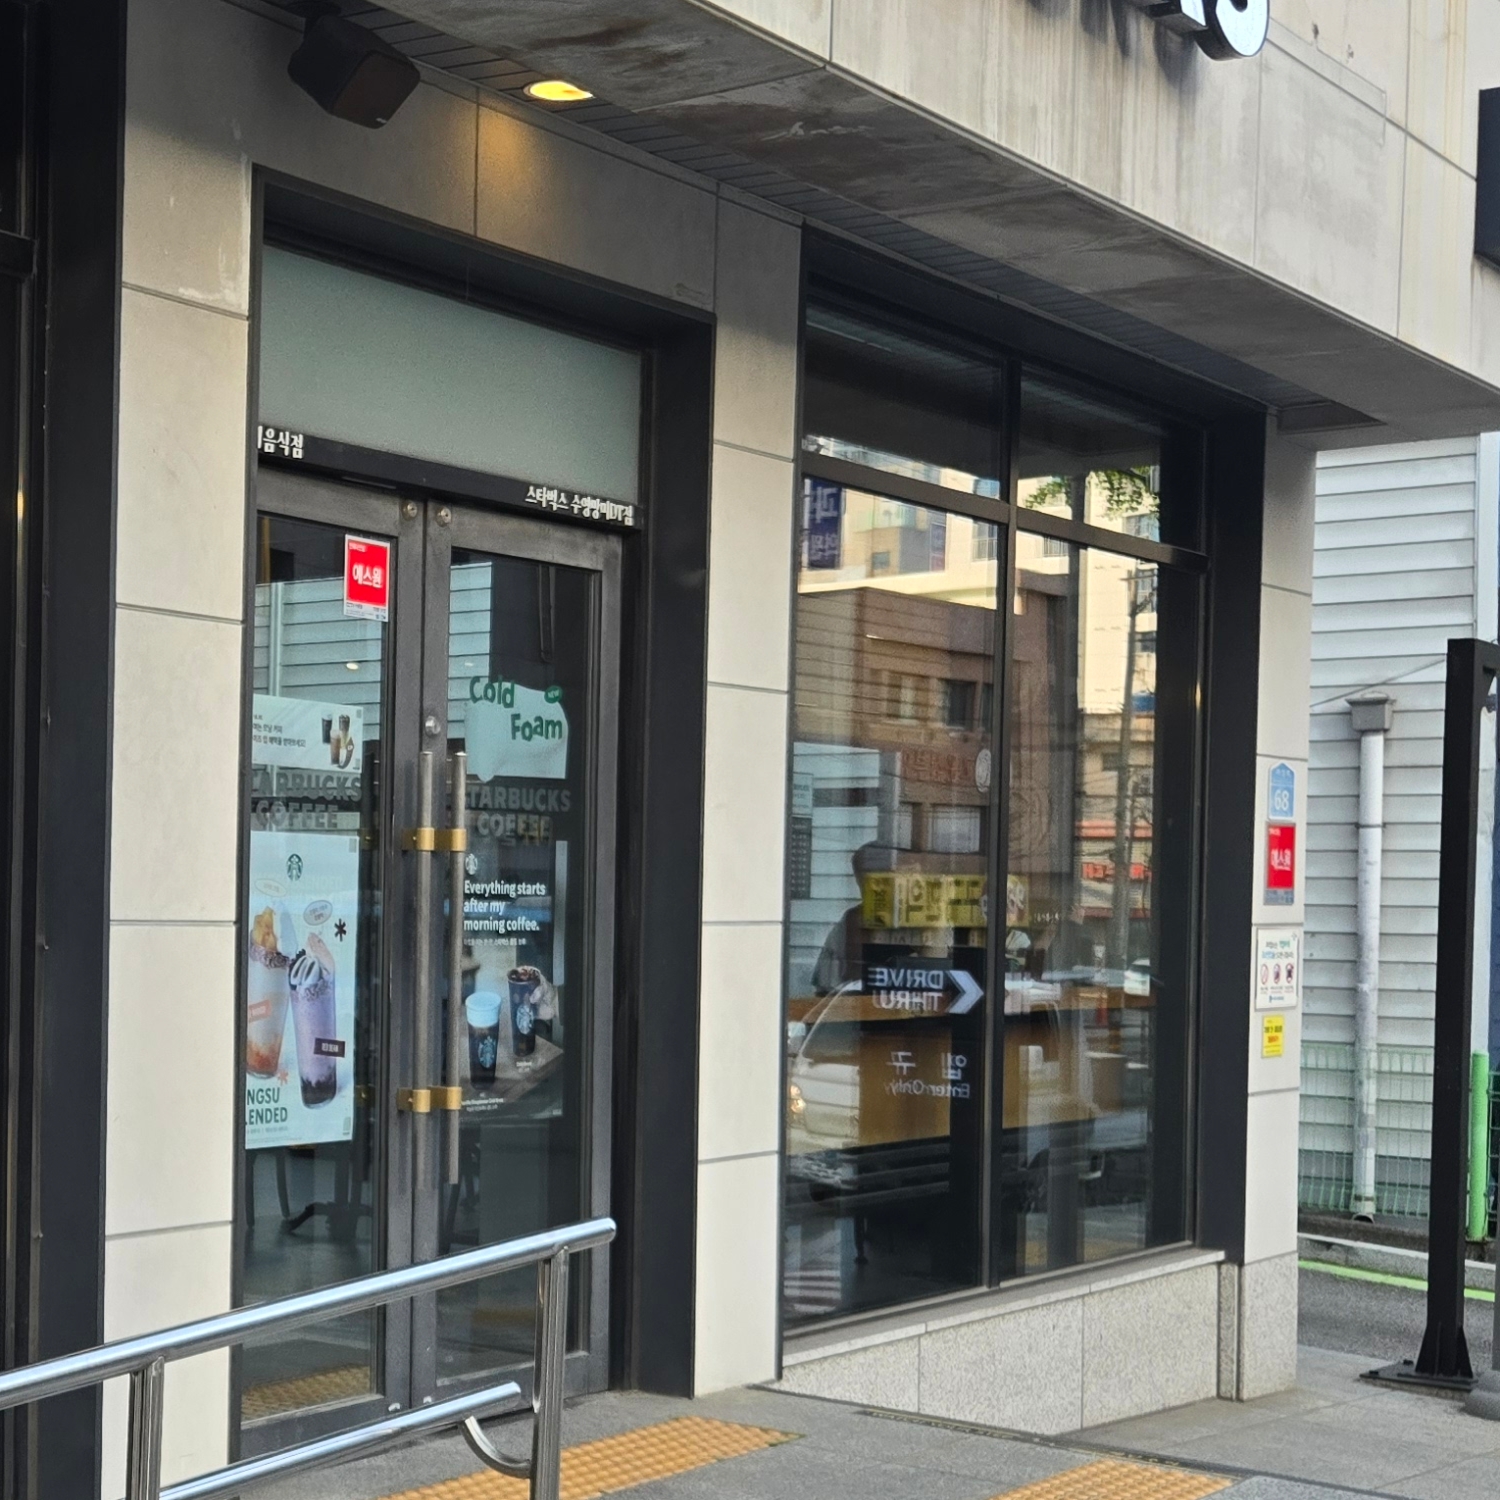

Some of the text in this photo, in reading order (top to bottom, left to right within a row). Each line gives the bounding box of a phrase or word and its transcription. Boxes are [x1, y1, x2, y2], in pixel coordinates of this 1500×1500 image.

[525, 486, 569, 511] 스타벅스
[353, 564, 383, 588] 에스원
[470, 675, 515, 708] Cold
[511, 713, 562, 741] Foam
[1274, 790, 1290, 811] 68
[256, 800, 338, 828] COFFEE
[477, 812, 552, 837] COFFEE
[464, 880, 546, 898] Everything starts
[463, 898, 505, 915] after my
[463, 917, 540, 933] morning coffee.
[246, 1107, 288, 1126] ENDED
